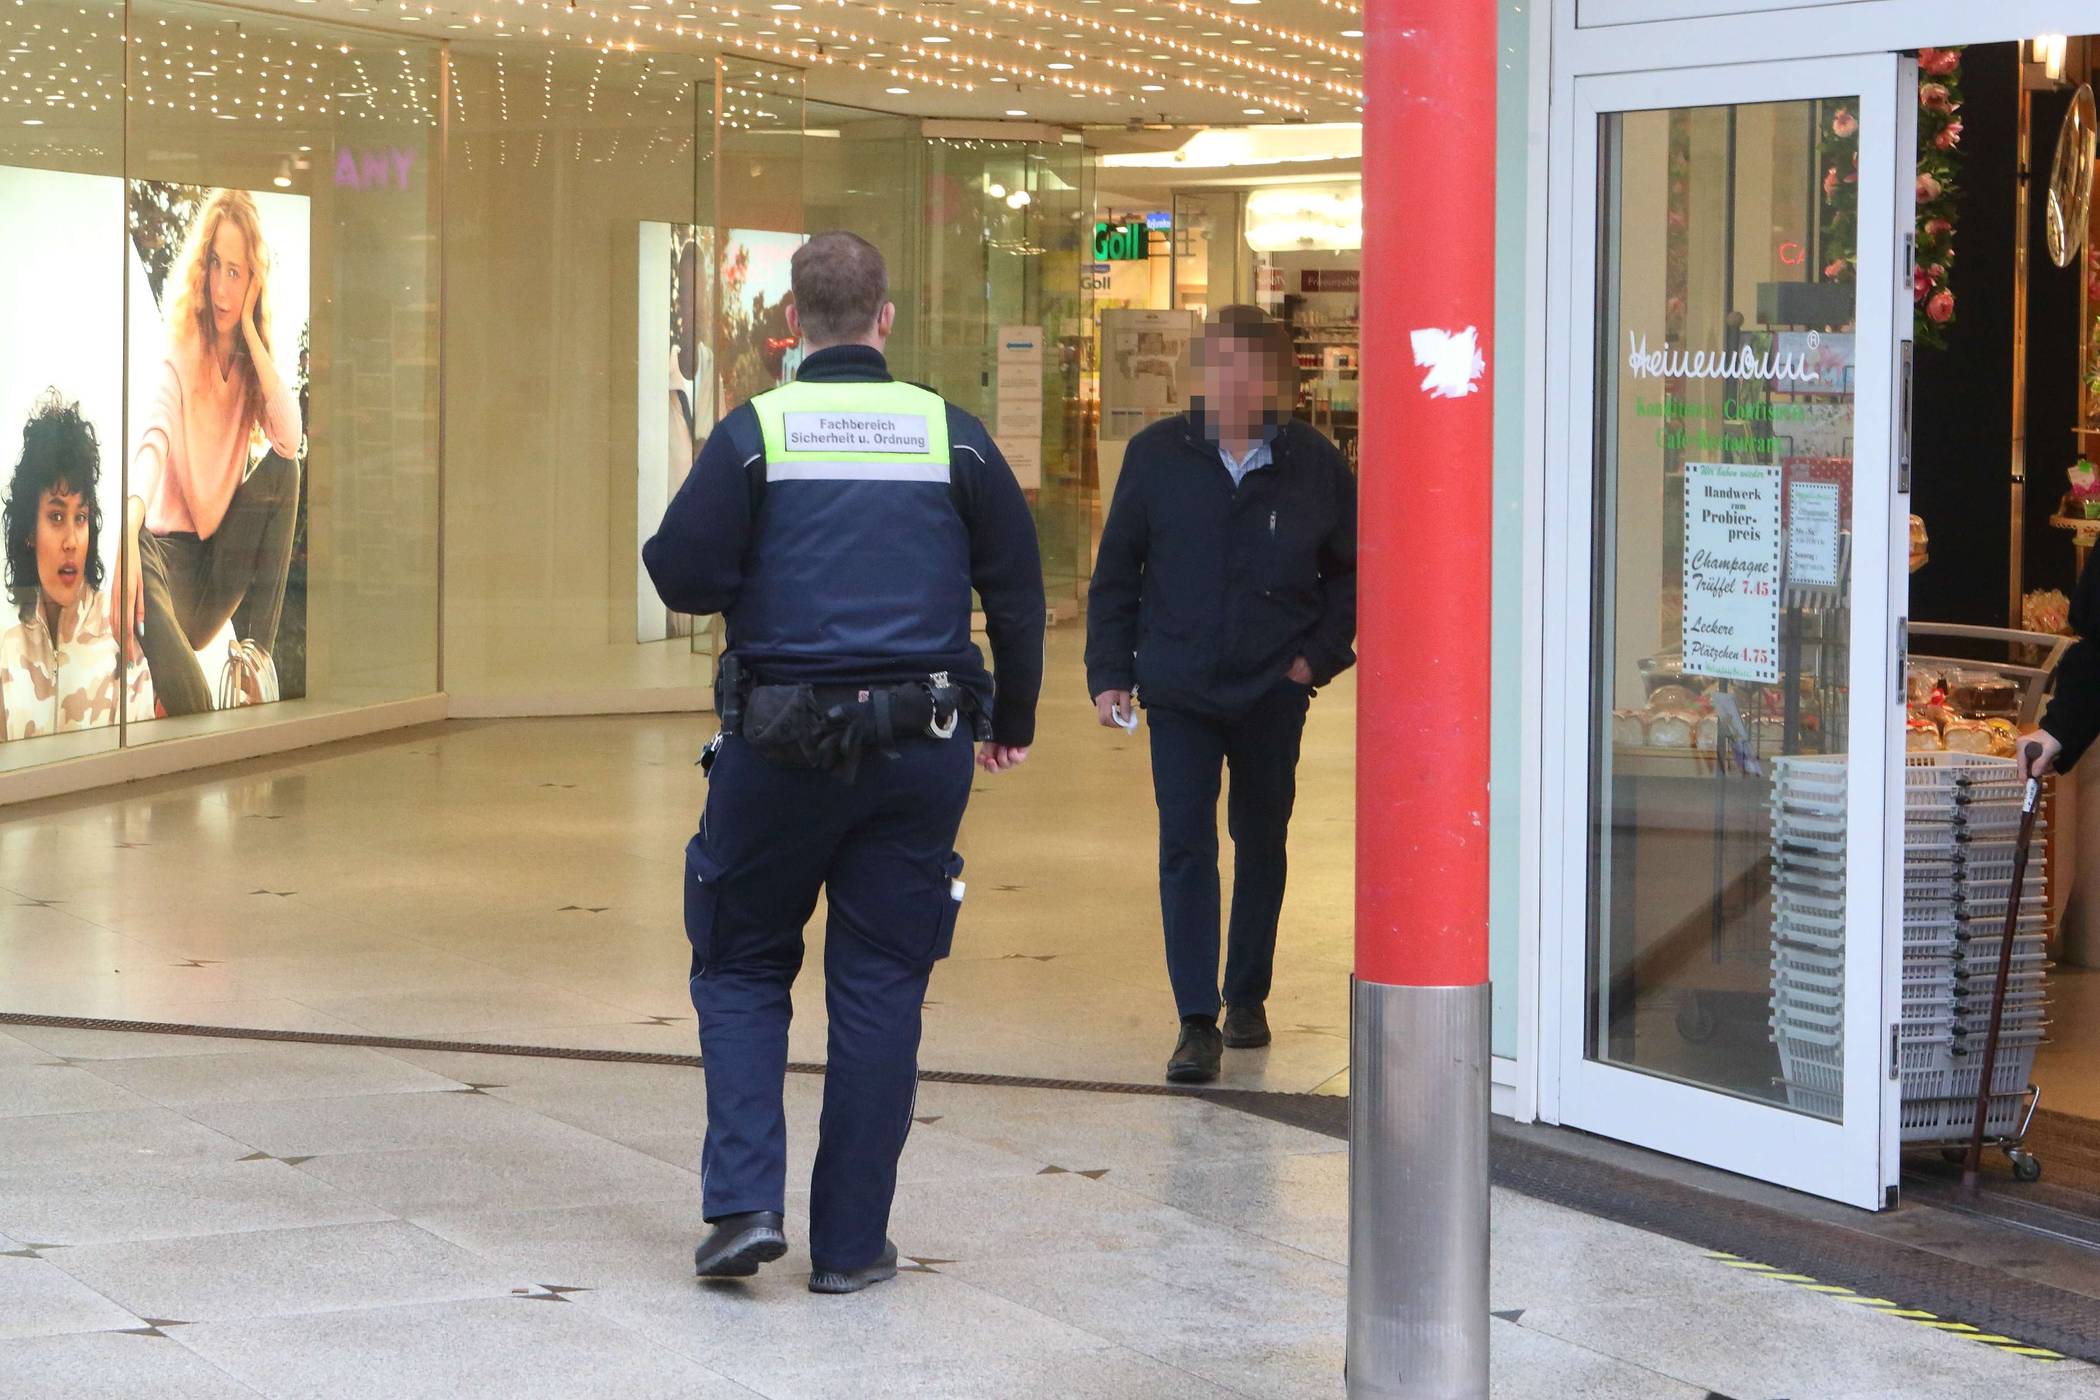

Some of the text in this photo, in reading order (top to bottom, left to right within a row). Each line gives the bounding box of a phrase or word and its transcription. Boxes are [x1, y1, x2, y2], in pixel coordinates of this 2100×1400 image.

[1093, 222, 1139, 262] Goll
[1080, 276, 1111, 290] Goll
[819, 417, 896, 431] Fachbereich
[791, 432, 926, 448] Sicherheit u. Ordnung
[1704, 485, 1761, 501] Handwerk
[1702, 509, 1757, 525] Probier-
[1728, 526, 1761, 543] preis
[1691, 549, 1770, 577] Champagne
[1692, 573, 1736, 598] Trüffel
[1690, 616, 1734, 636] Leckere
[1691, 640, 1739, 662] Plätzchen
